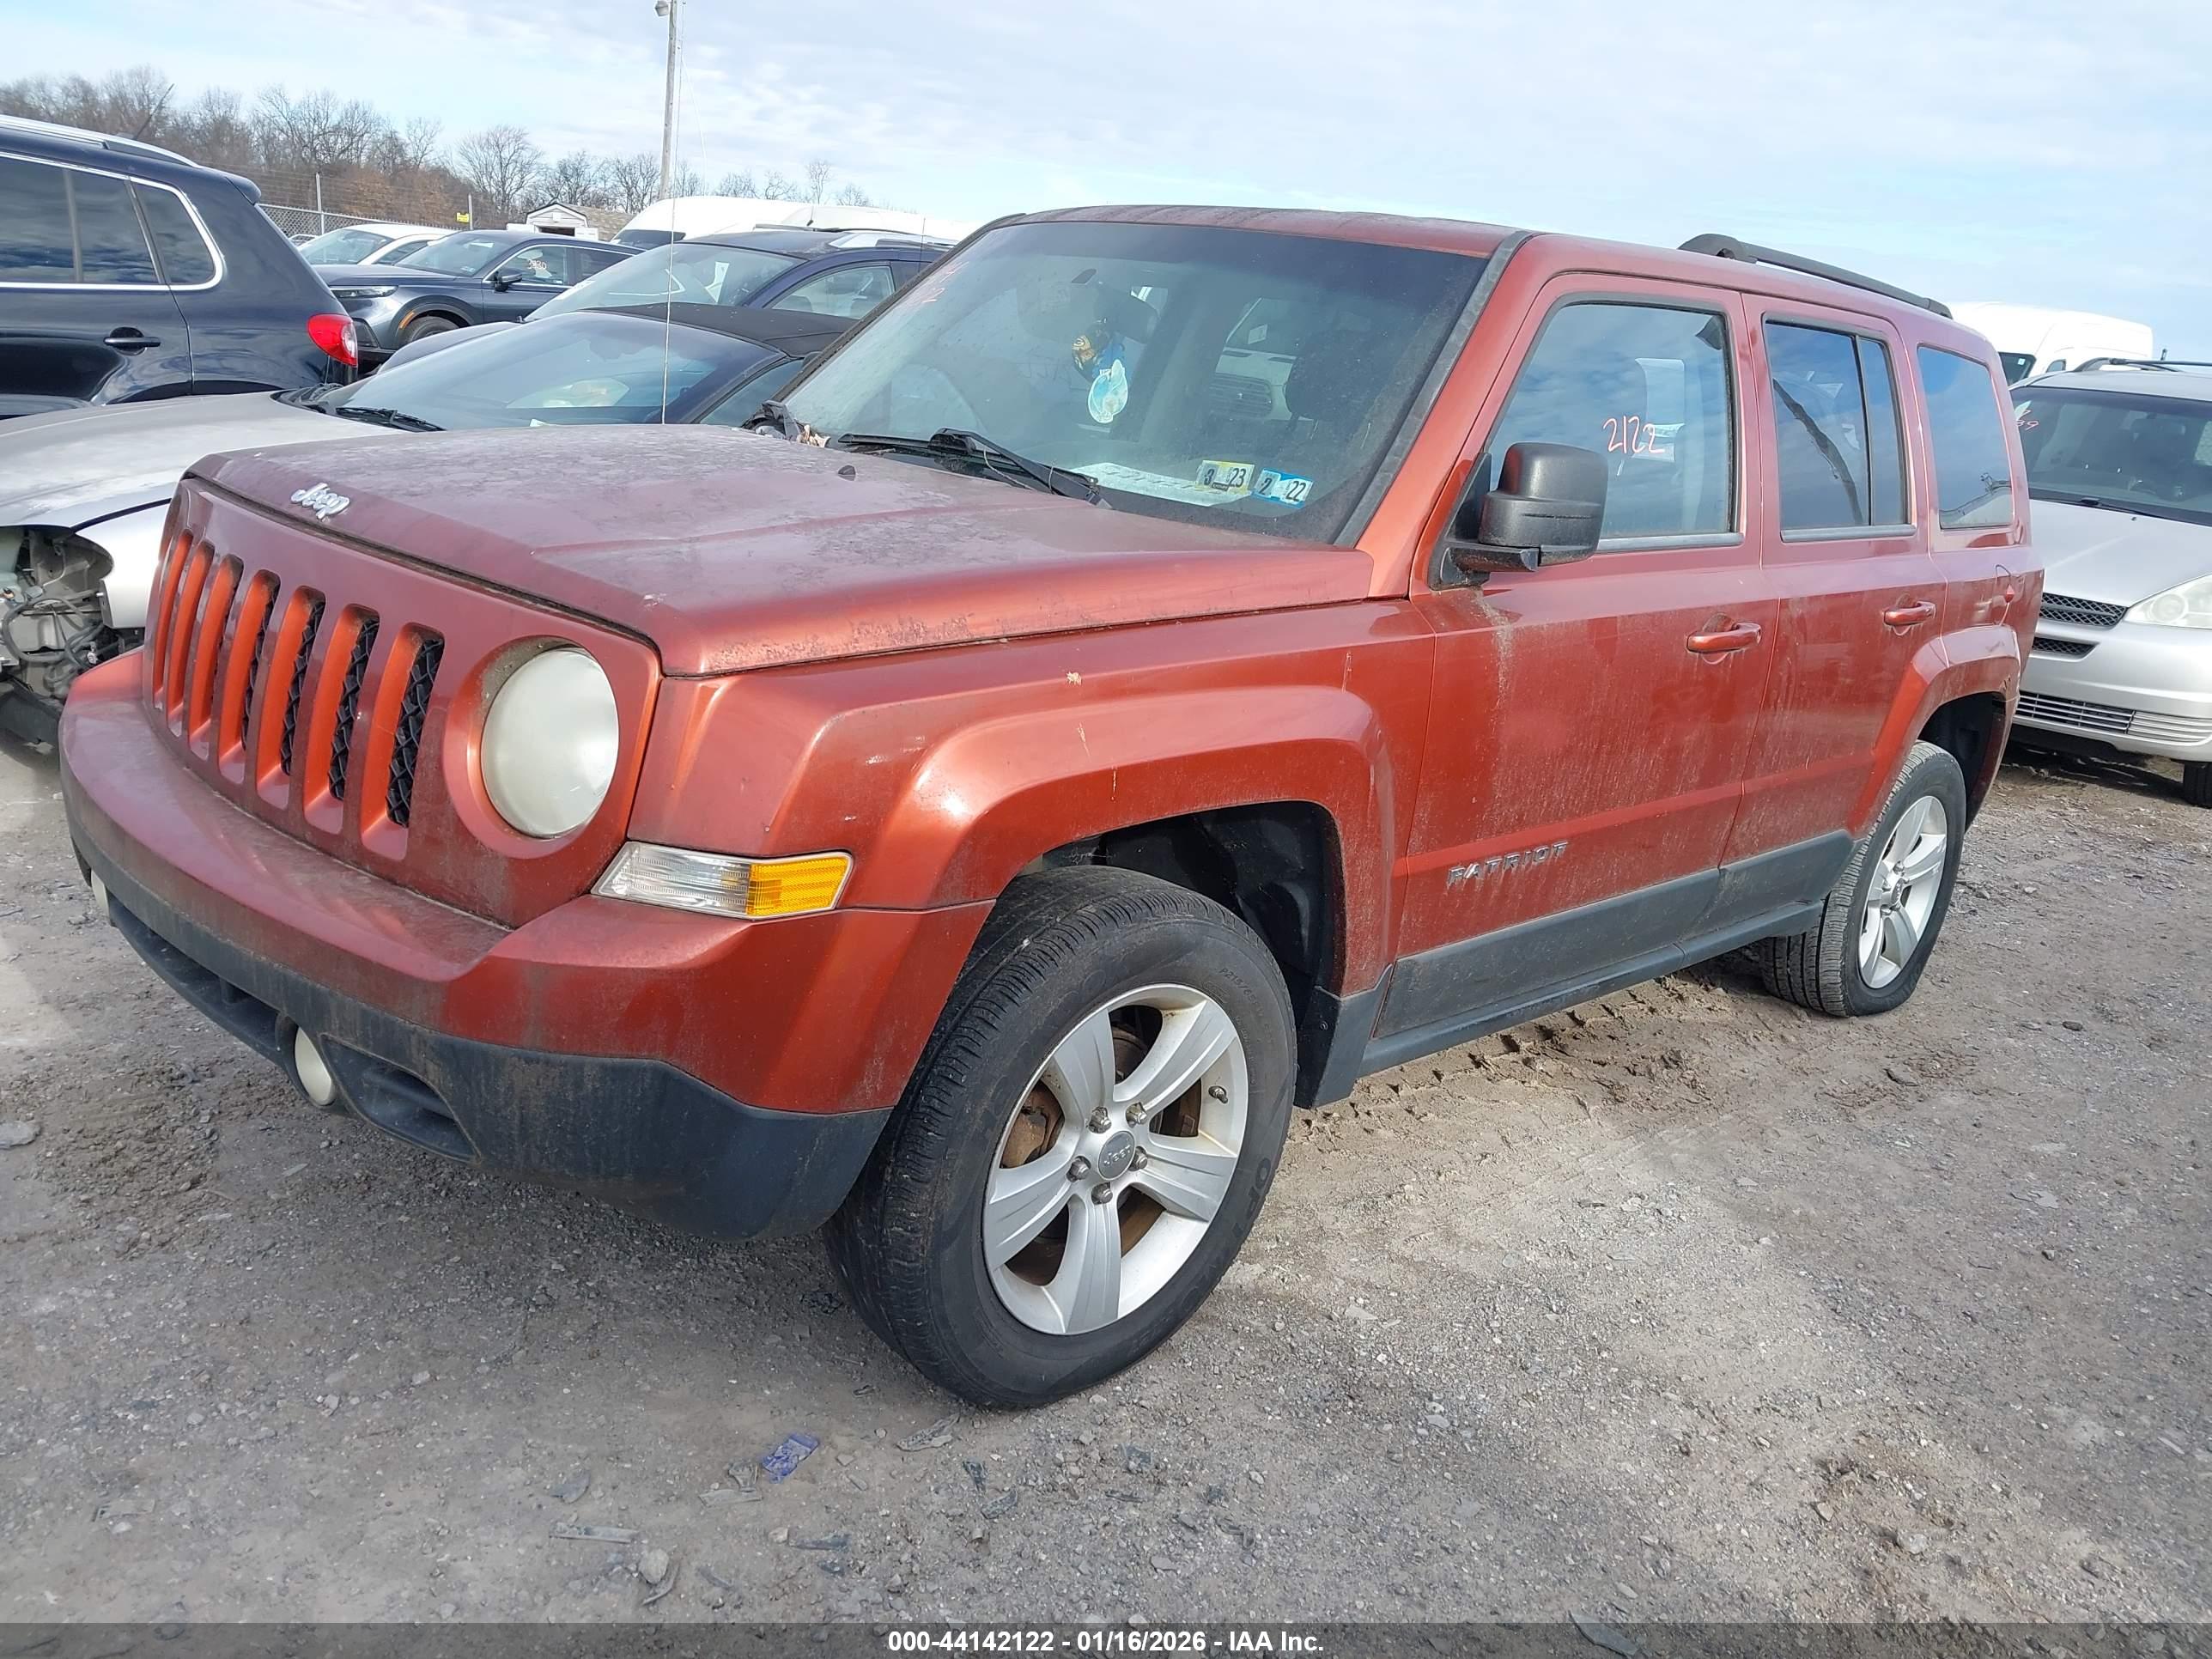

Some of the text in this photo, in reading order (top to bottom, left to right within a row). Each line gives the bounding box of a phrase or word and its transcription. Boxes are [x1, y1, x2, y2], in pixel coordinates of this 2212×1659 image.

[1602, 415, 1666, 453] 2122
[1204, 468, 1215, 485] 3
[1229, 468, 1247, 488] 23
[1258, 477, 1307, 501] 2 22
[290, 482, 350, 520] Jeep
[1447, 840, 1569, 884] PATRIOT
